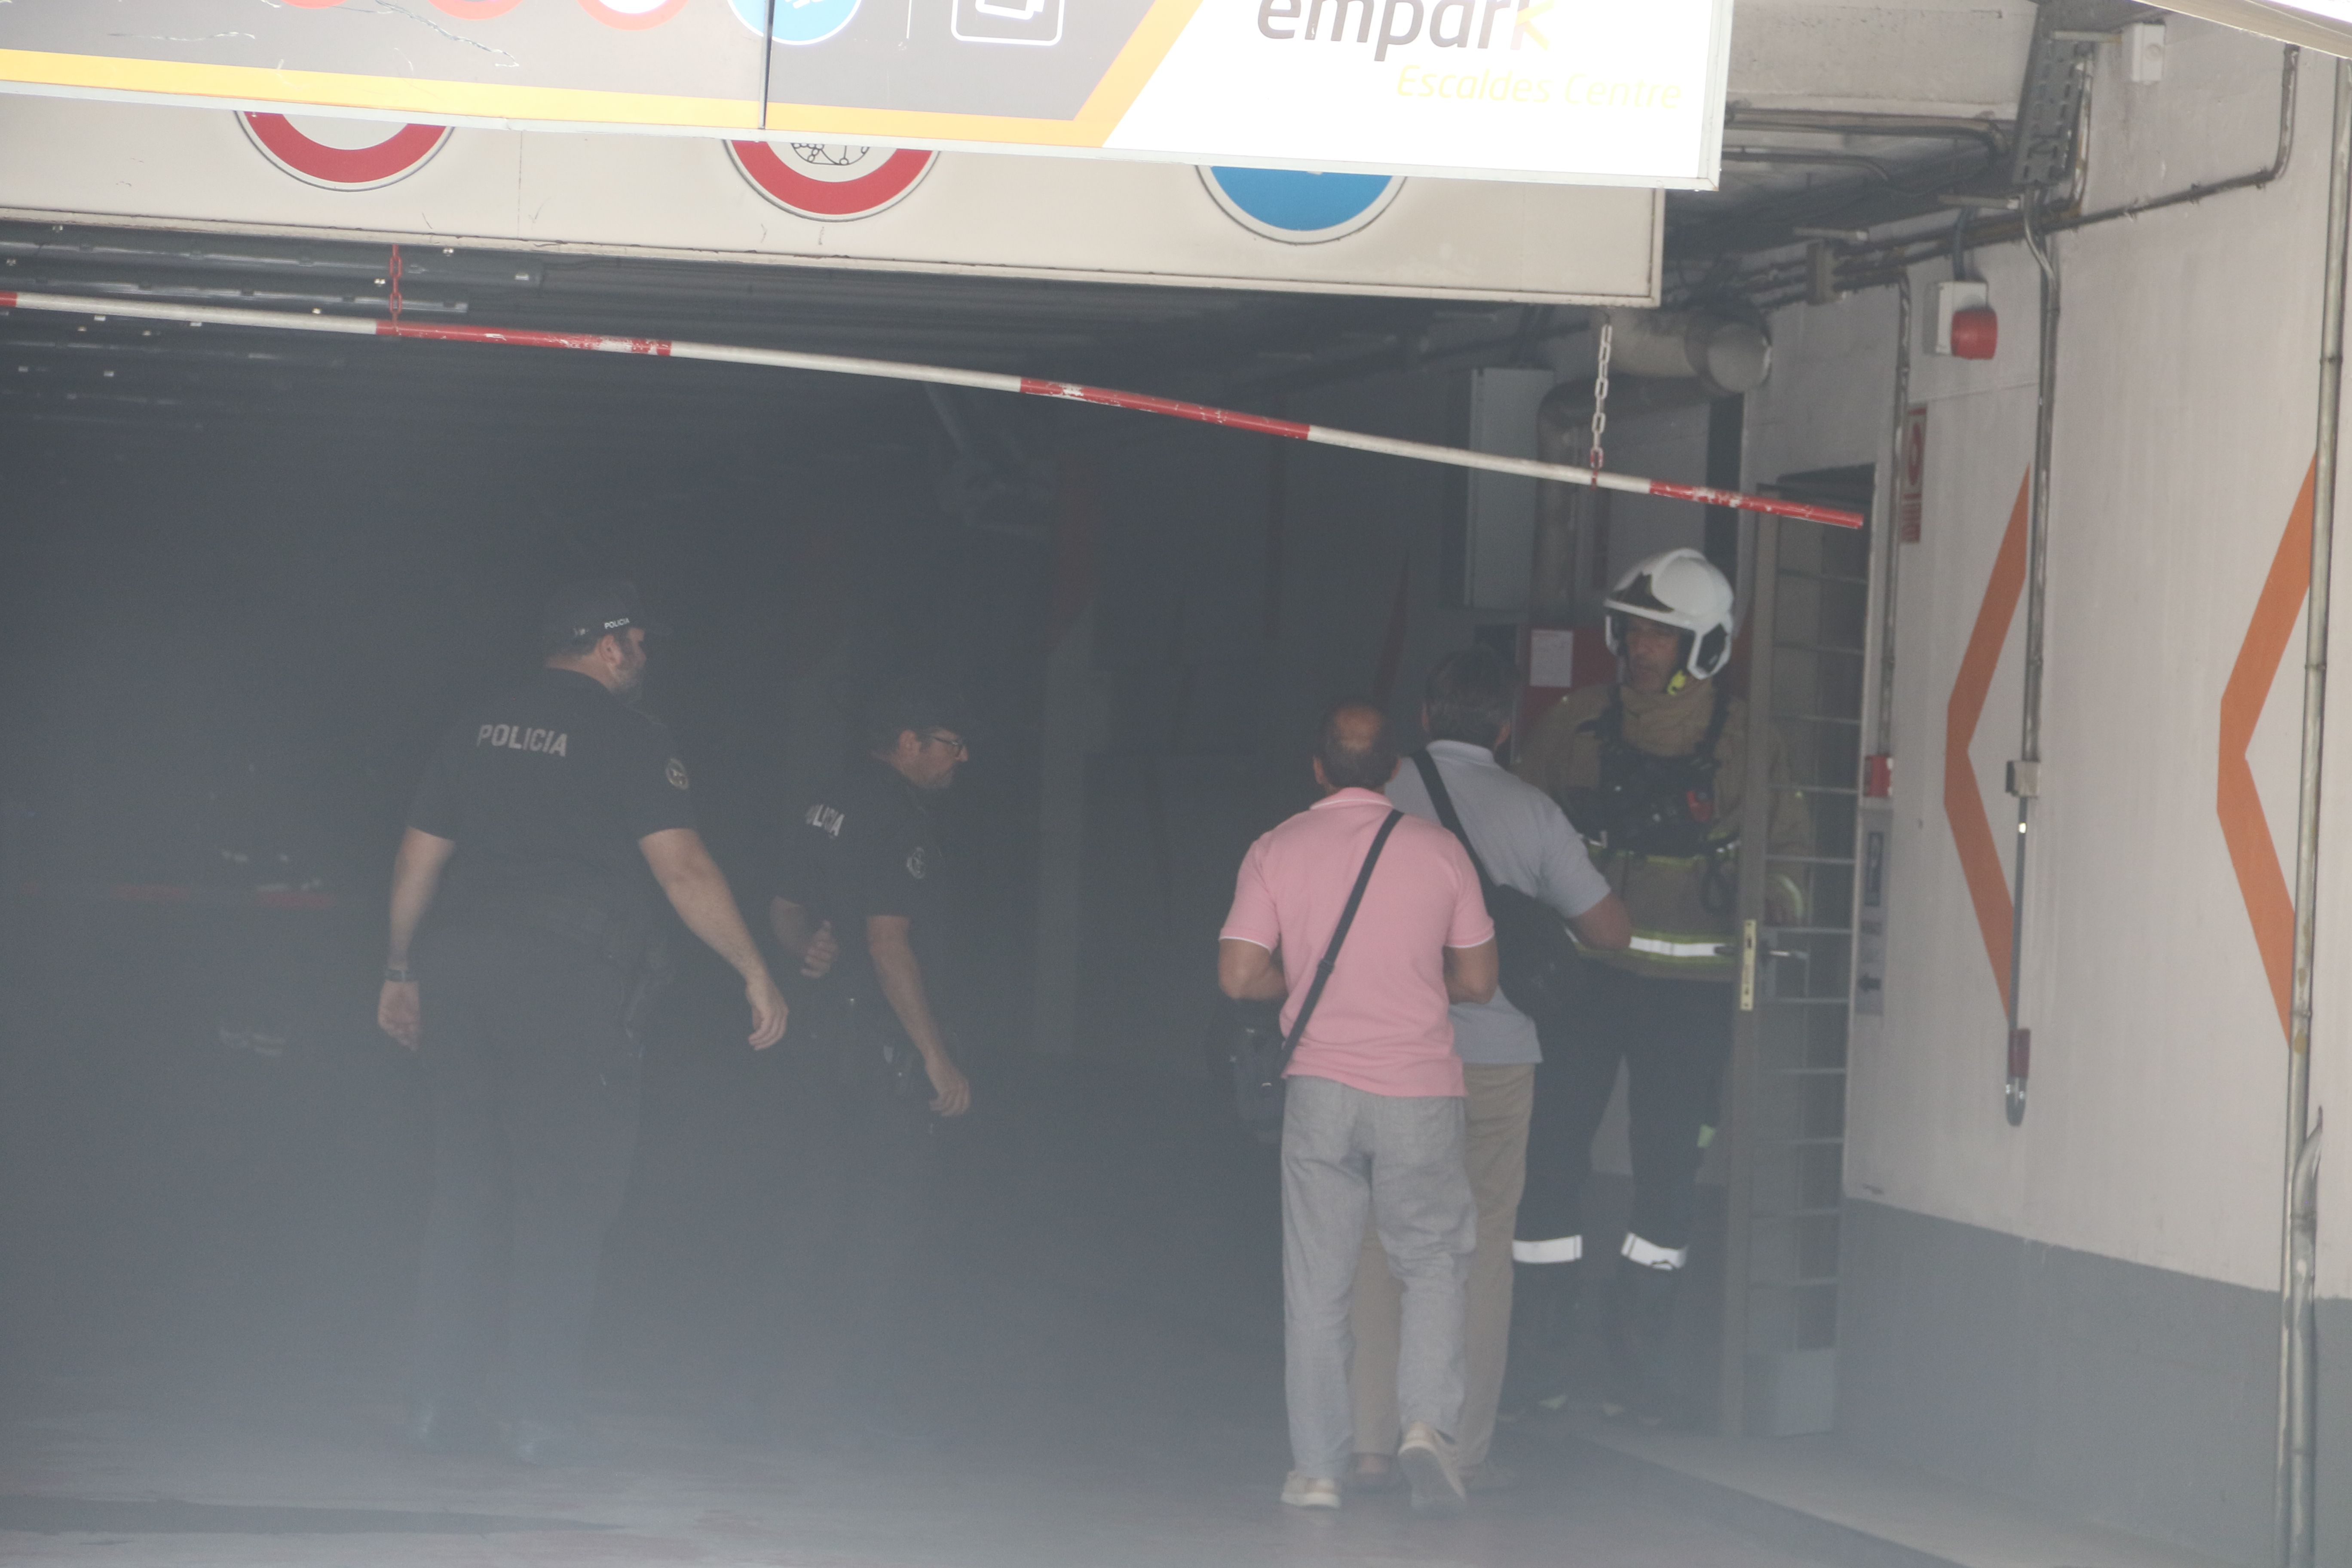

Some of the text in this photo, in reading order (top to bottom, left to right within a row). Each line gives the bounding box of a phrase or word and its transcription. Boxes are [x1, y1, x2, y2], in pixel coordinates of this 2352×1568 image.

[1257, 0, 1553, 61] empark
[1396, 64, 1681, 108] Escaldes Centre
[604, 618, 630, 629] POLICIA
[477, 724, 567, 757] POLICIA
